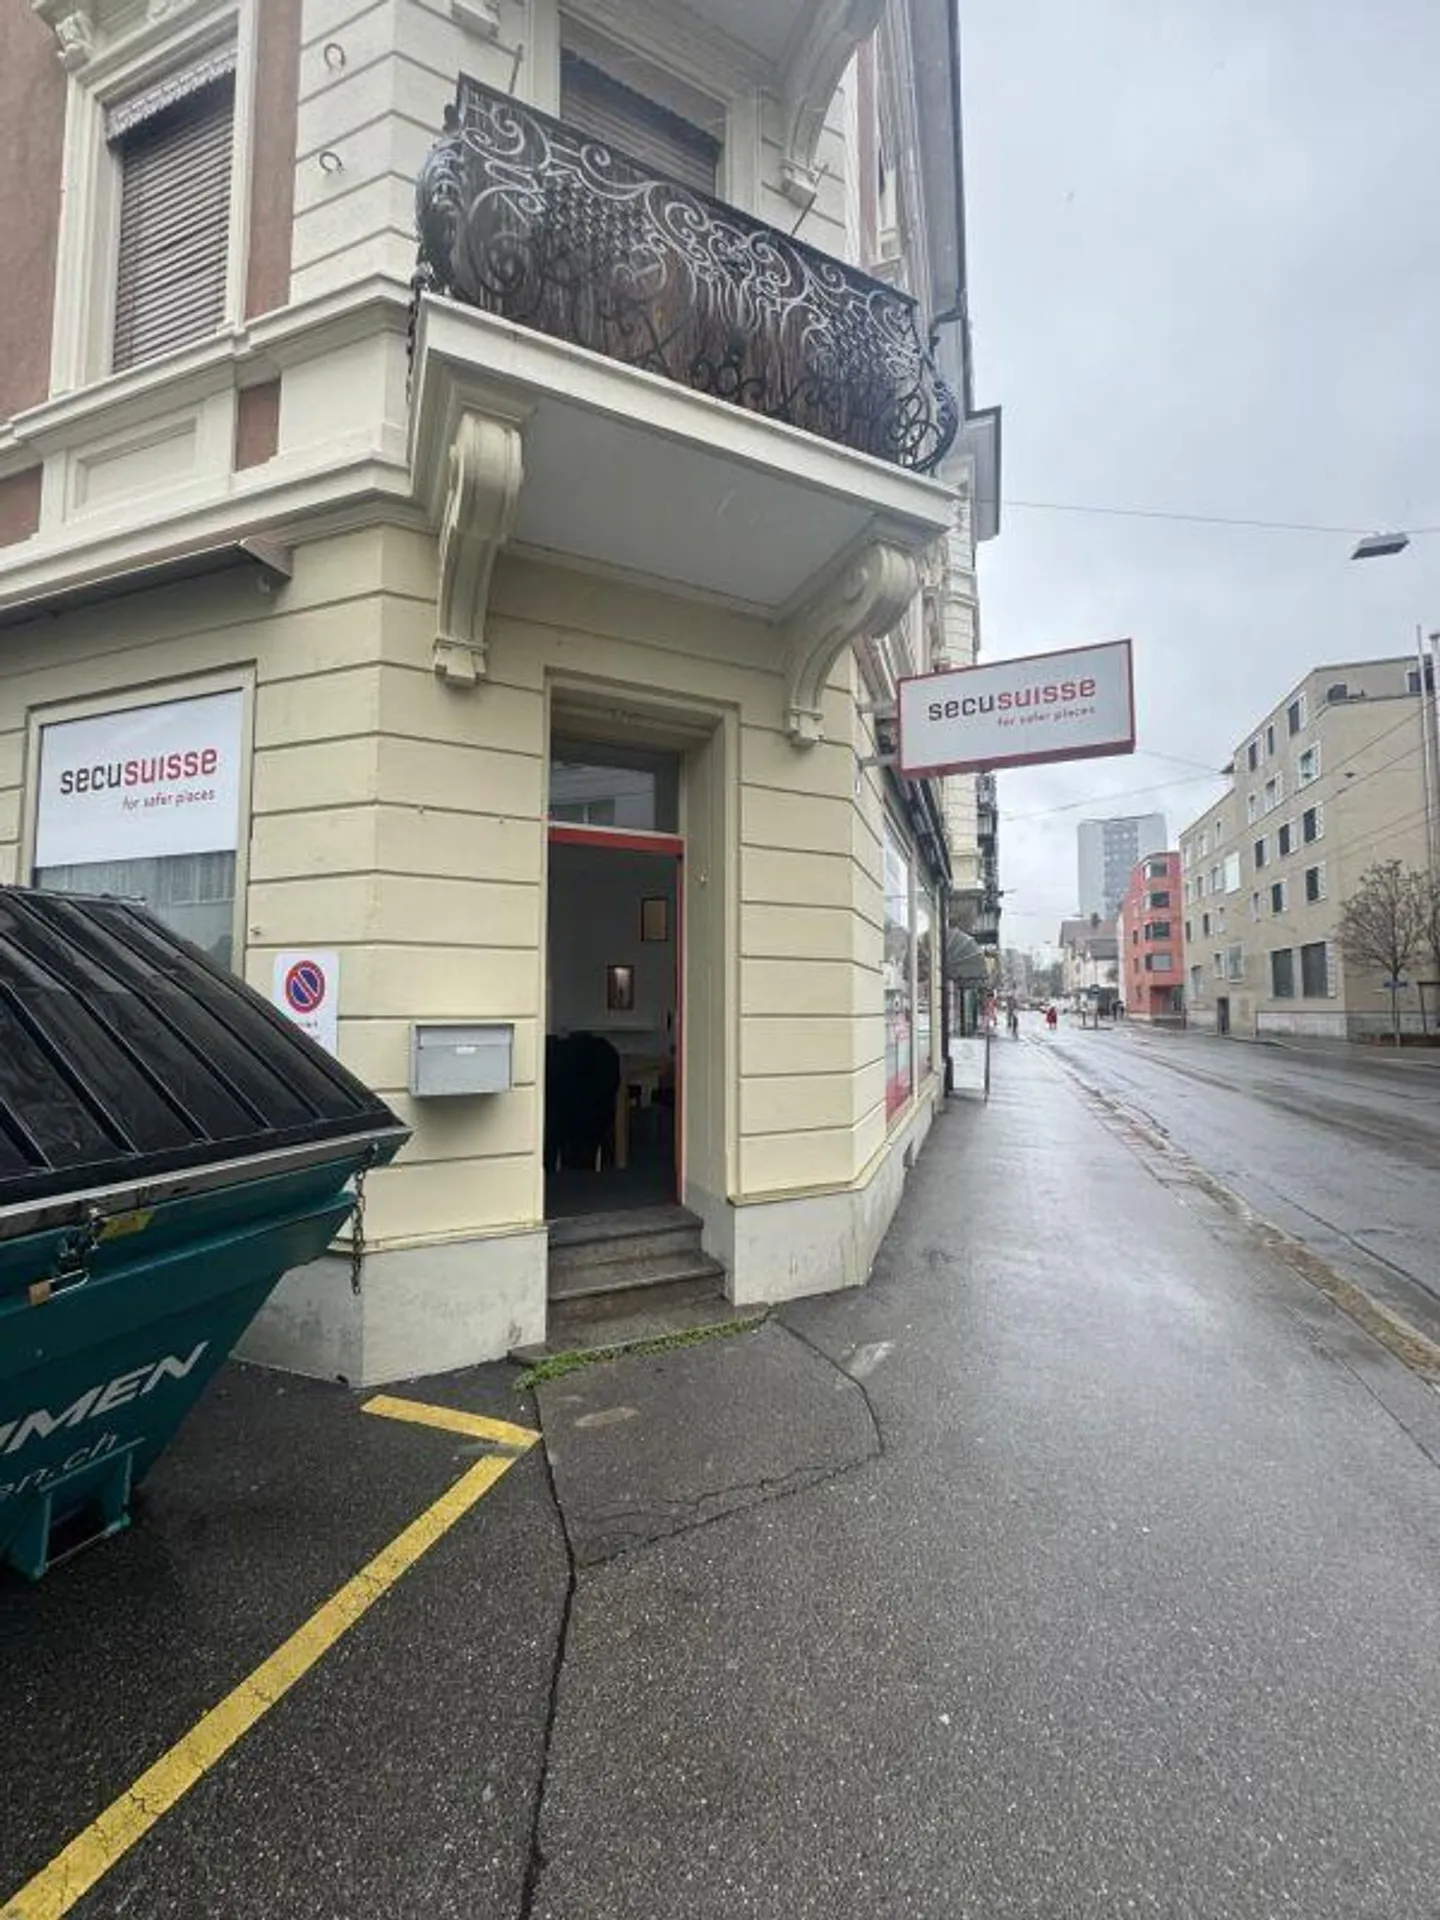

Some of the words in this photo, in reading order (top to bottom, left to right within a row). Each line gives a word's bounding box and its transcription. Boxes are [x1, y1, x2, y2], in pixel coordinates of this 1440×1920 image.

[928, 678, 1096, 721] secusuisse
[60, 749, 217, 795] secusuisse
[123, 795, 139, 810] for
[144, 792, 173, 808] safer
[175, 789, 215, 807] places
[0, 1340, 209, 1453] MEN
